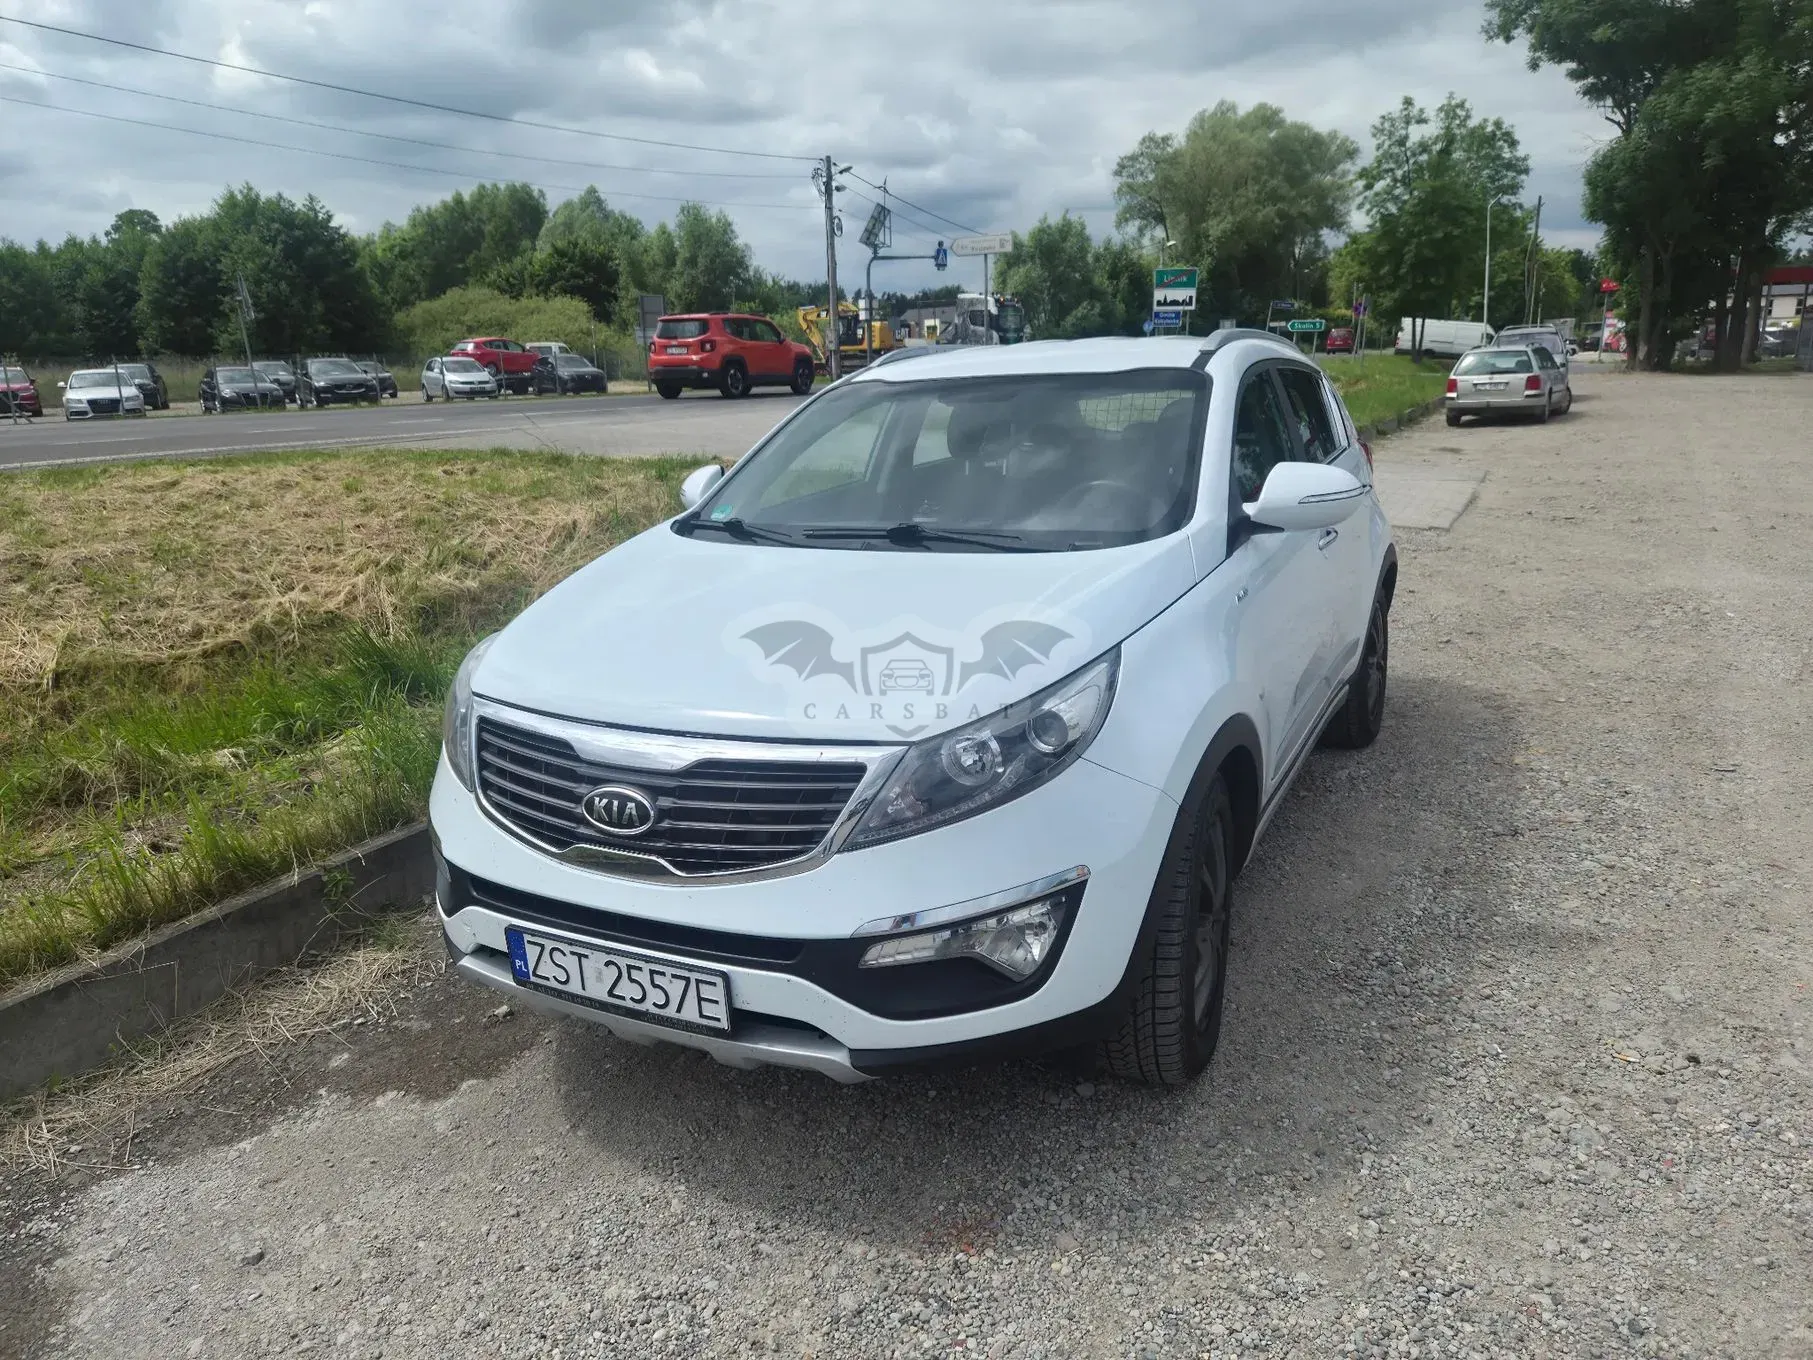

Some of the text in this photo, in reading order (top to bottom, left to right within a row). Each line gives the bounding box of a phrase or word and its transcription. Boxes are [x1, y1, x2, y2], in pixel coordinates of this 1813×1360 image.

[592, 796, 639, 827] KIA
[515, 958, 528, 972] PL
[526, 939, 722, 1023] ZST 2557E
